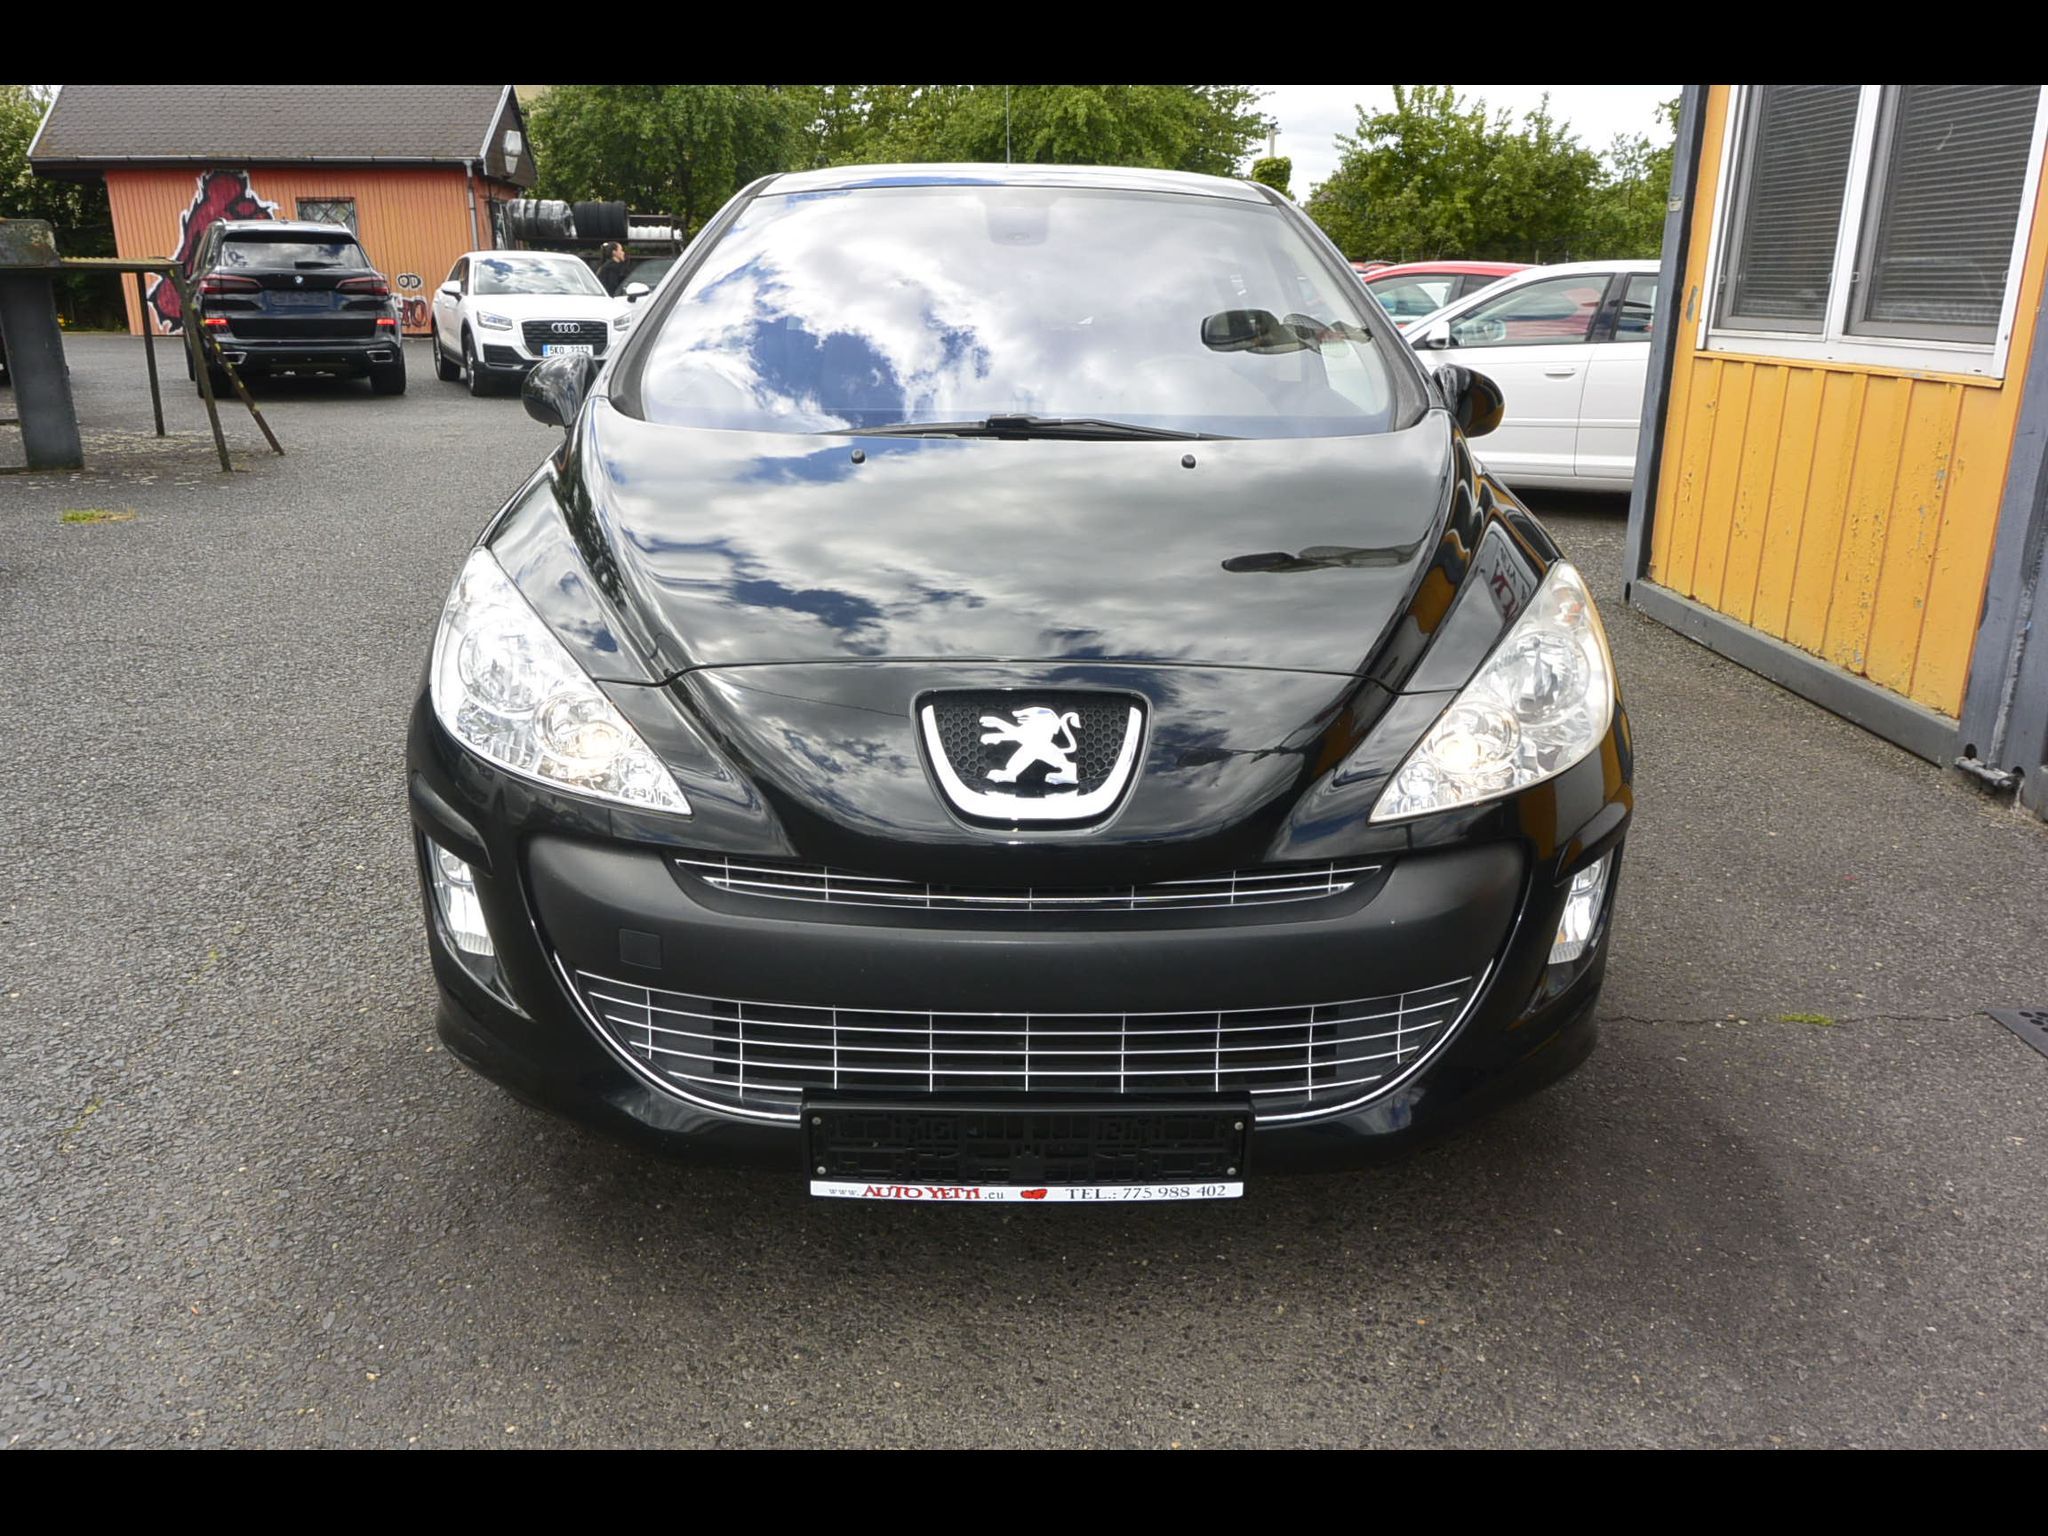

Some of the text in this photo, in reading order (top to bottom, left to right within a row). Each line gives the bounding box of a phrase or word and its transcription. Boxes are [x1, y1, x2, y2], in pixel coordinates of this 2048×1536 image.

[1065, 1188, 1116, 1200] TEL.:
[1123, 1187, 1152, 1199] 775
[1158, 1186, 1190, 1198] 988
[1196, 1185, 1226, 1197] 402
